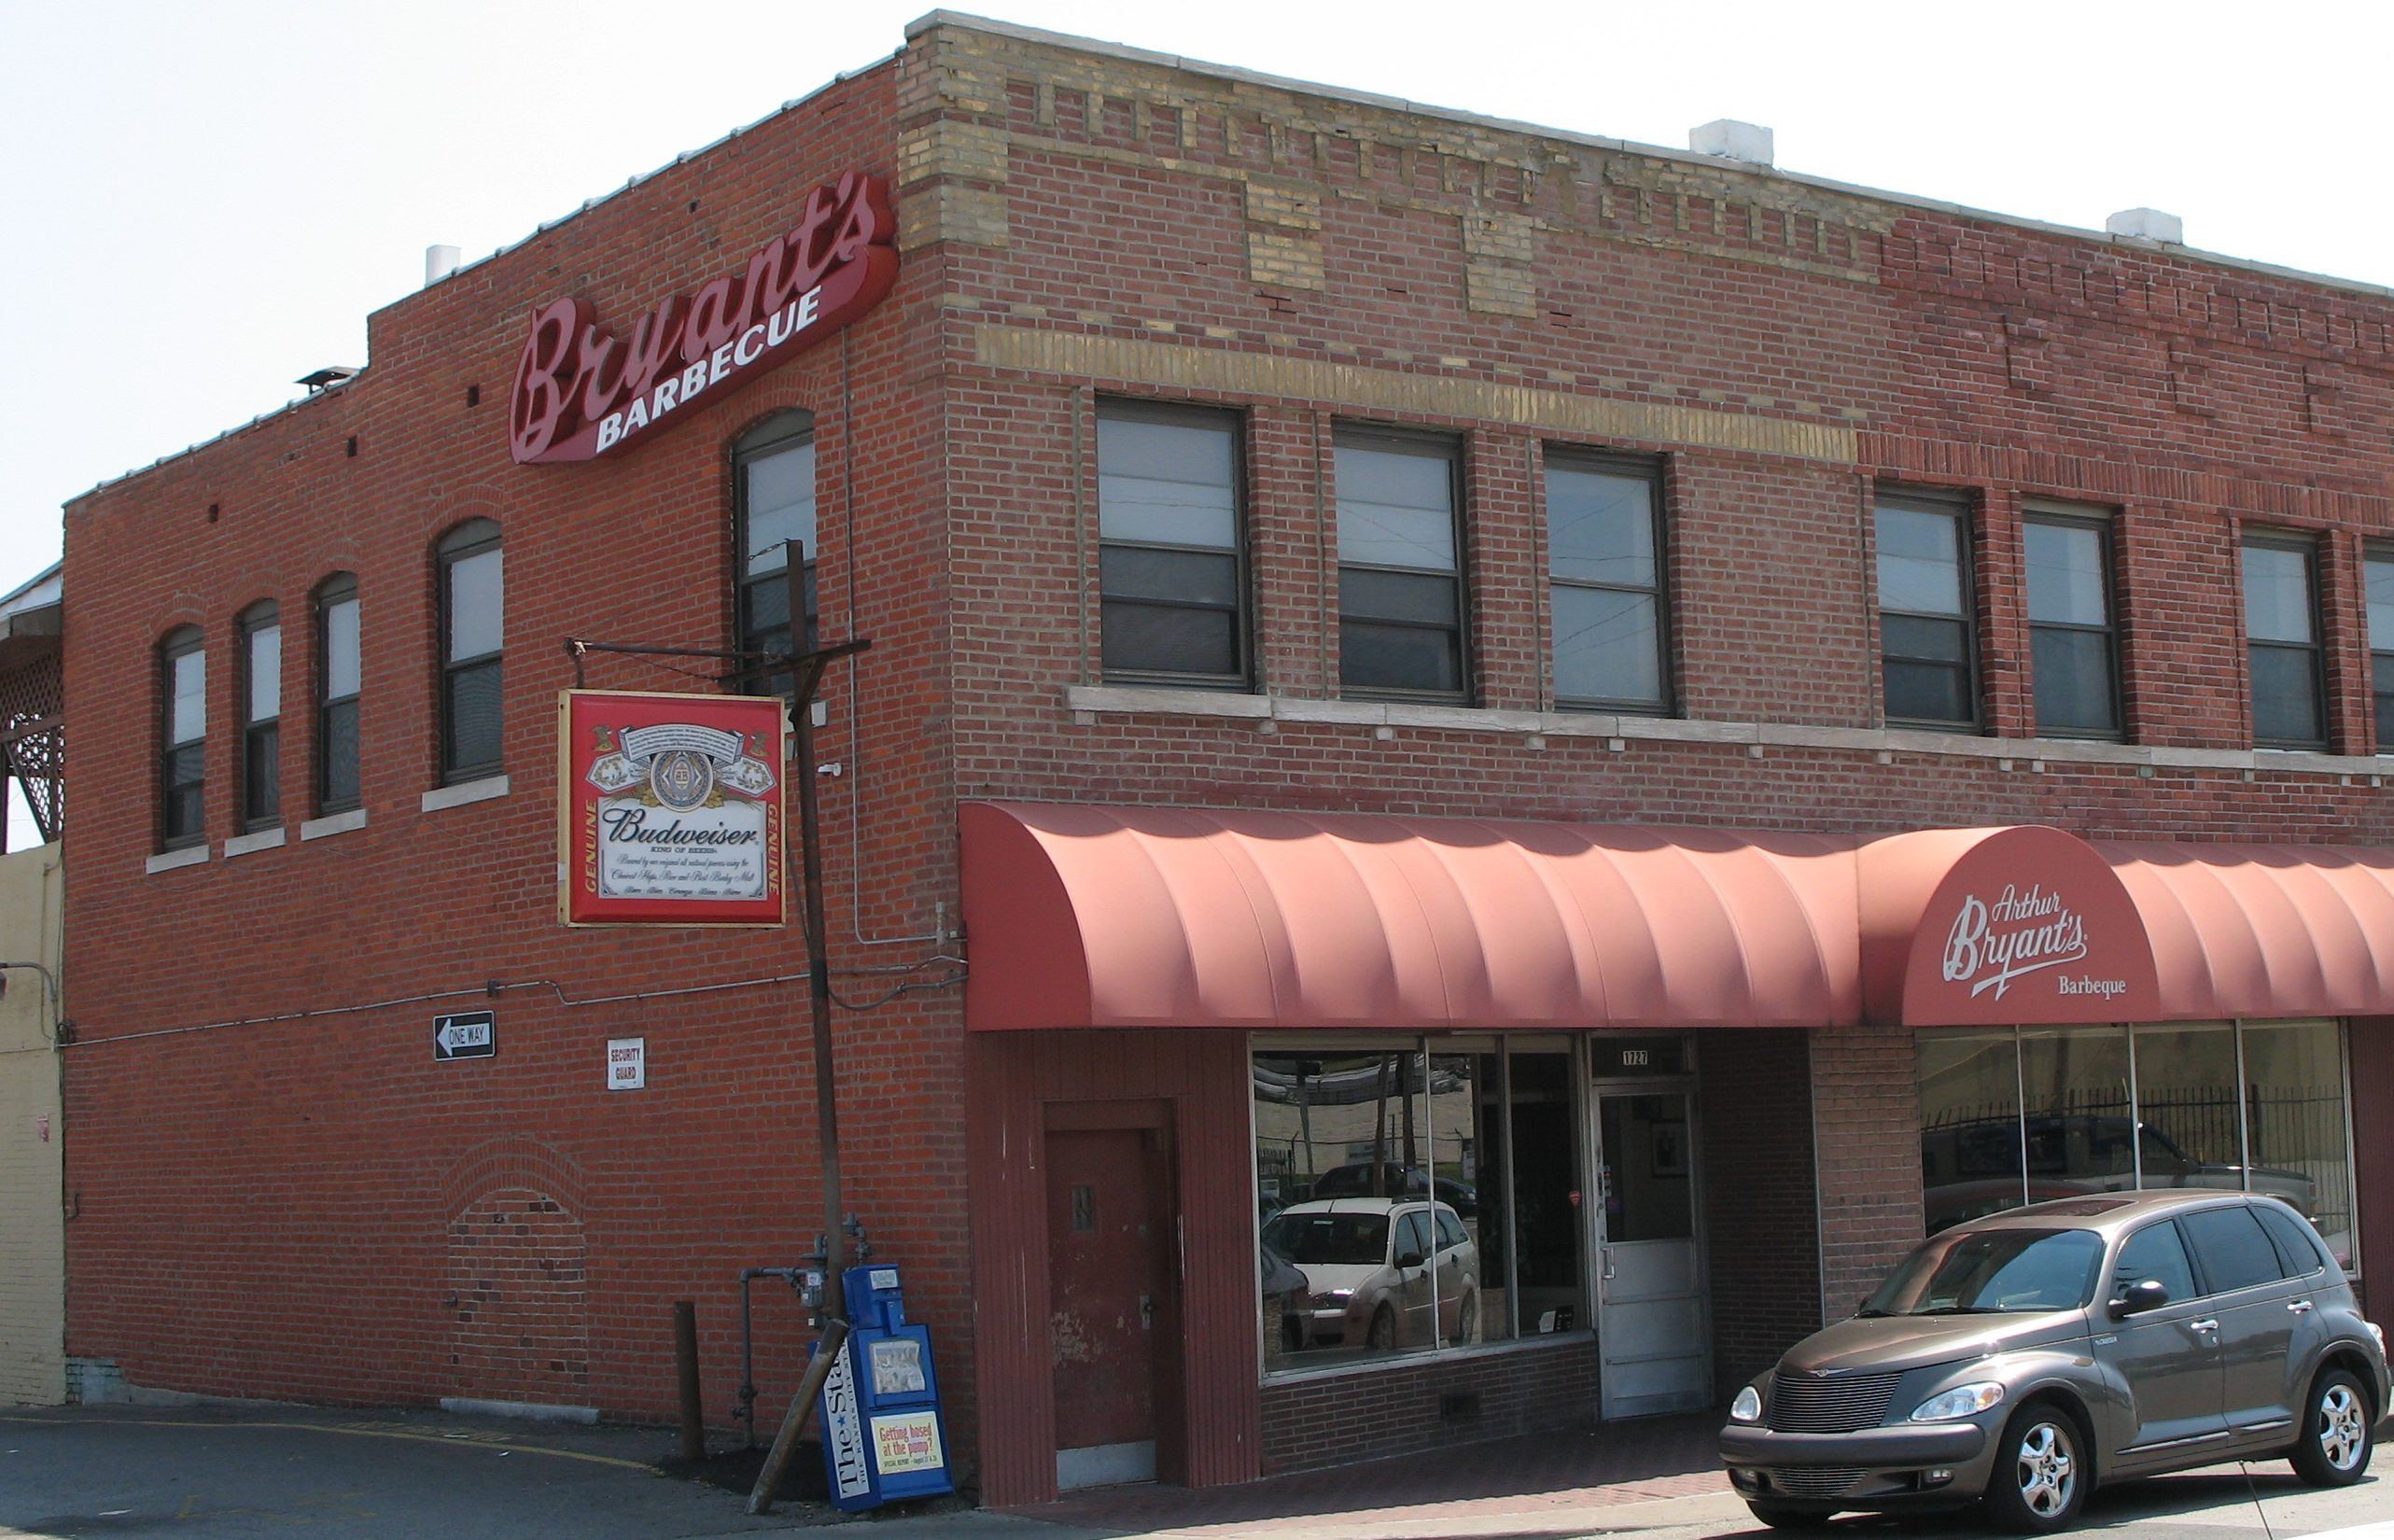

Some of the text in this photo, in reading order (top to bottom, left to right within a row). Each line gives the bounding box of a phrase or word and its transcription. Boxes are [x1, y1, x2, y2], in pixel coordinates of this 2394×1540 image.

[510, 170, 877, 464] Bryant's
[596, 285, 822, 454] BARBECUE
[585, 799, 597, 893] GENUINE
[602, 808, 757, 846] Budweiser
[767, 803, 780, 896] GENUINE
[1993, 884, 2062, 922] Arthur
[1942, 894, 2087, 1001] Bryant's
[2059, 975, 2126, 1001] Barbeque
[449, 1026, 484, 1044] ONE WAY
[611, 1047, 640, 1062] SECURITY
[616, 1066, 636, 1080] GUARD
[1625, 1052, 1646, 1064] 1727
[846, 1376, 854, 1402] CITY
[827, 1356, 859, 1493] The Sta
[851, 1408, 862, 1453] KANSAS
[879, 1425, 909, 1443] Getting
[883, 1436, 932, 1457] at the pump?
